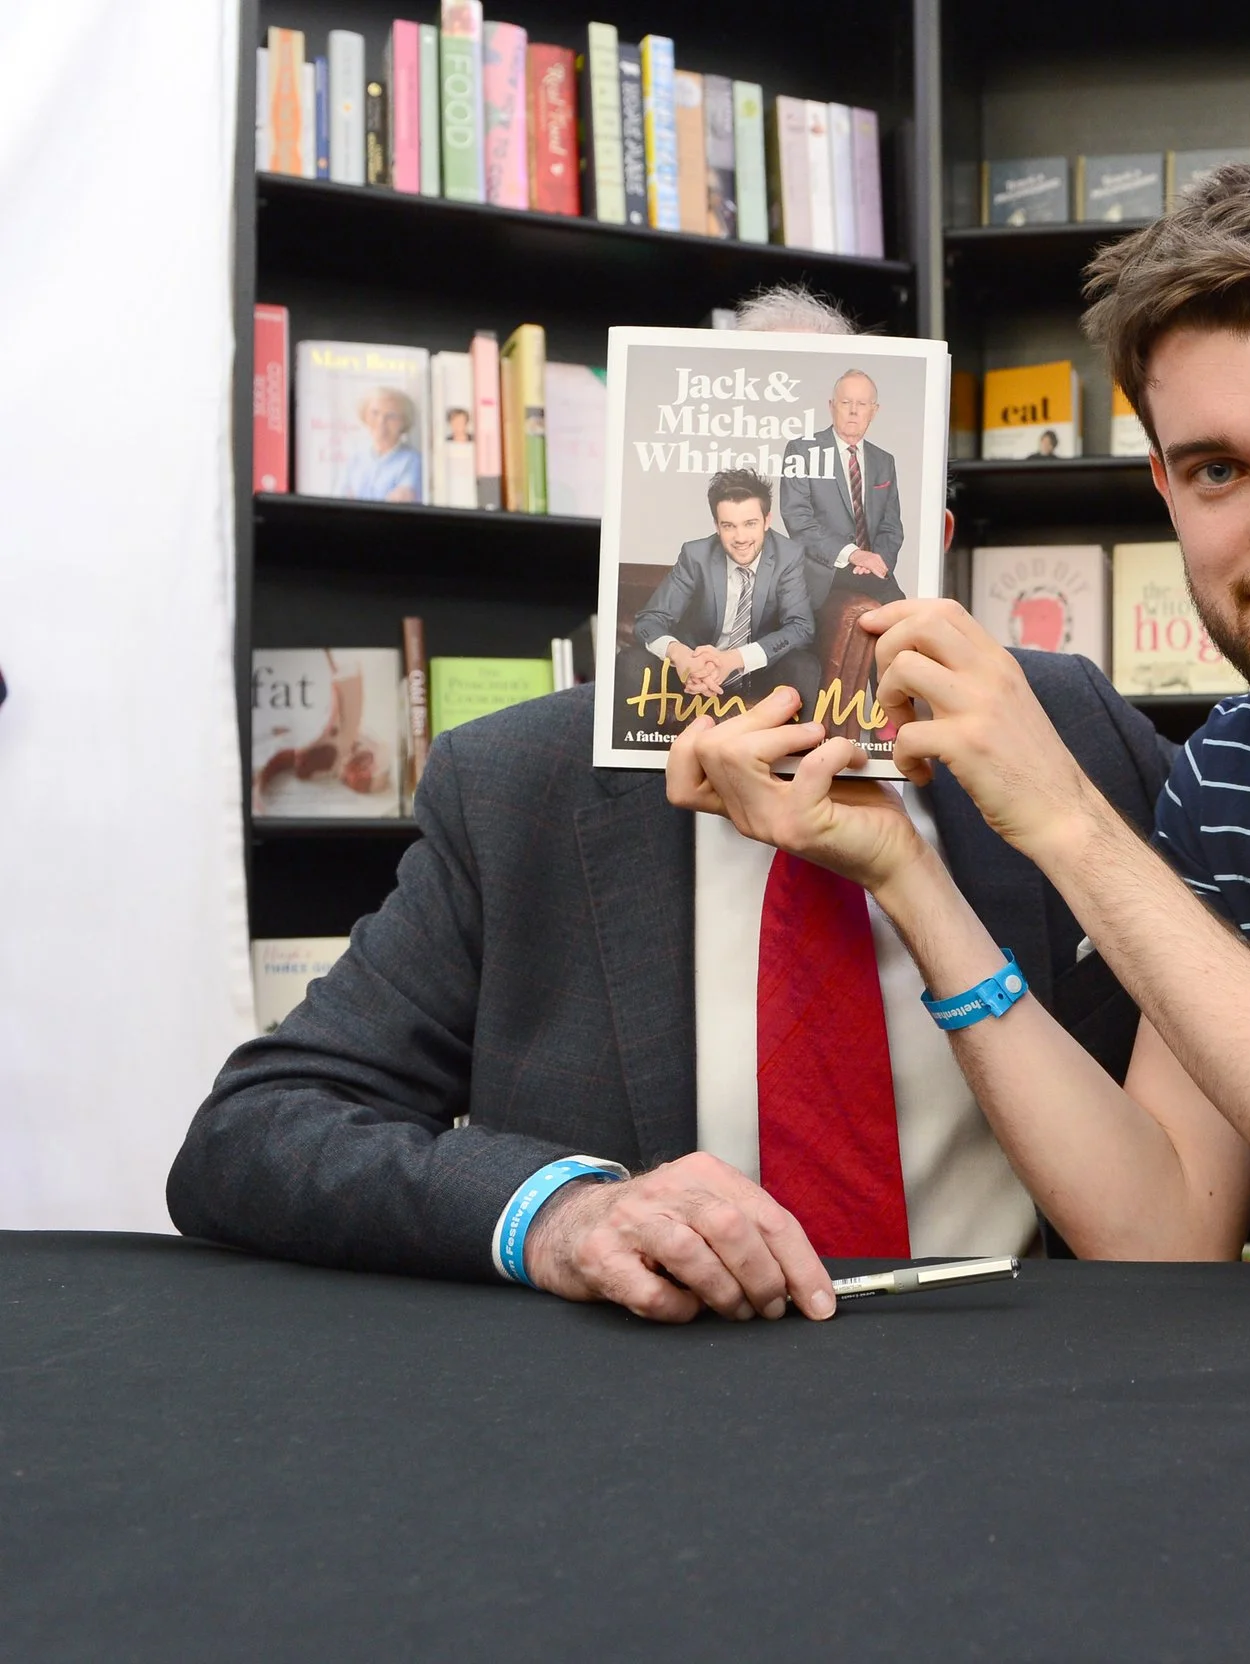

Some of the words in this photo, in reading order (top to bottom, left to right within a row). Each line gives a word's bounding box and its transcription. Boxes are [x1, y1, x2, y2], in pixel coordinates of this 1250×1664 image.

[444, 53, 473, 149] FOOD
[672, 367, 761, 406] Jack
[764, 371, 801, 403] &
[655, 403, 817, 441] Michael
[633, 440, 837, 479] Whitehall
[251, 666, 315, 710] fat
[627, 657, 750, 725] Him
[813, 677, 889, 730] Me
[624, 731, 634, 742] A
[636, 730, 679, 743] father
[506, 1189, 538, 1256] Festivals
